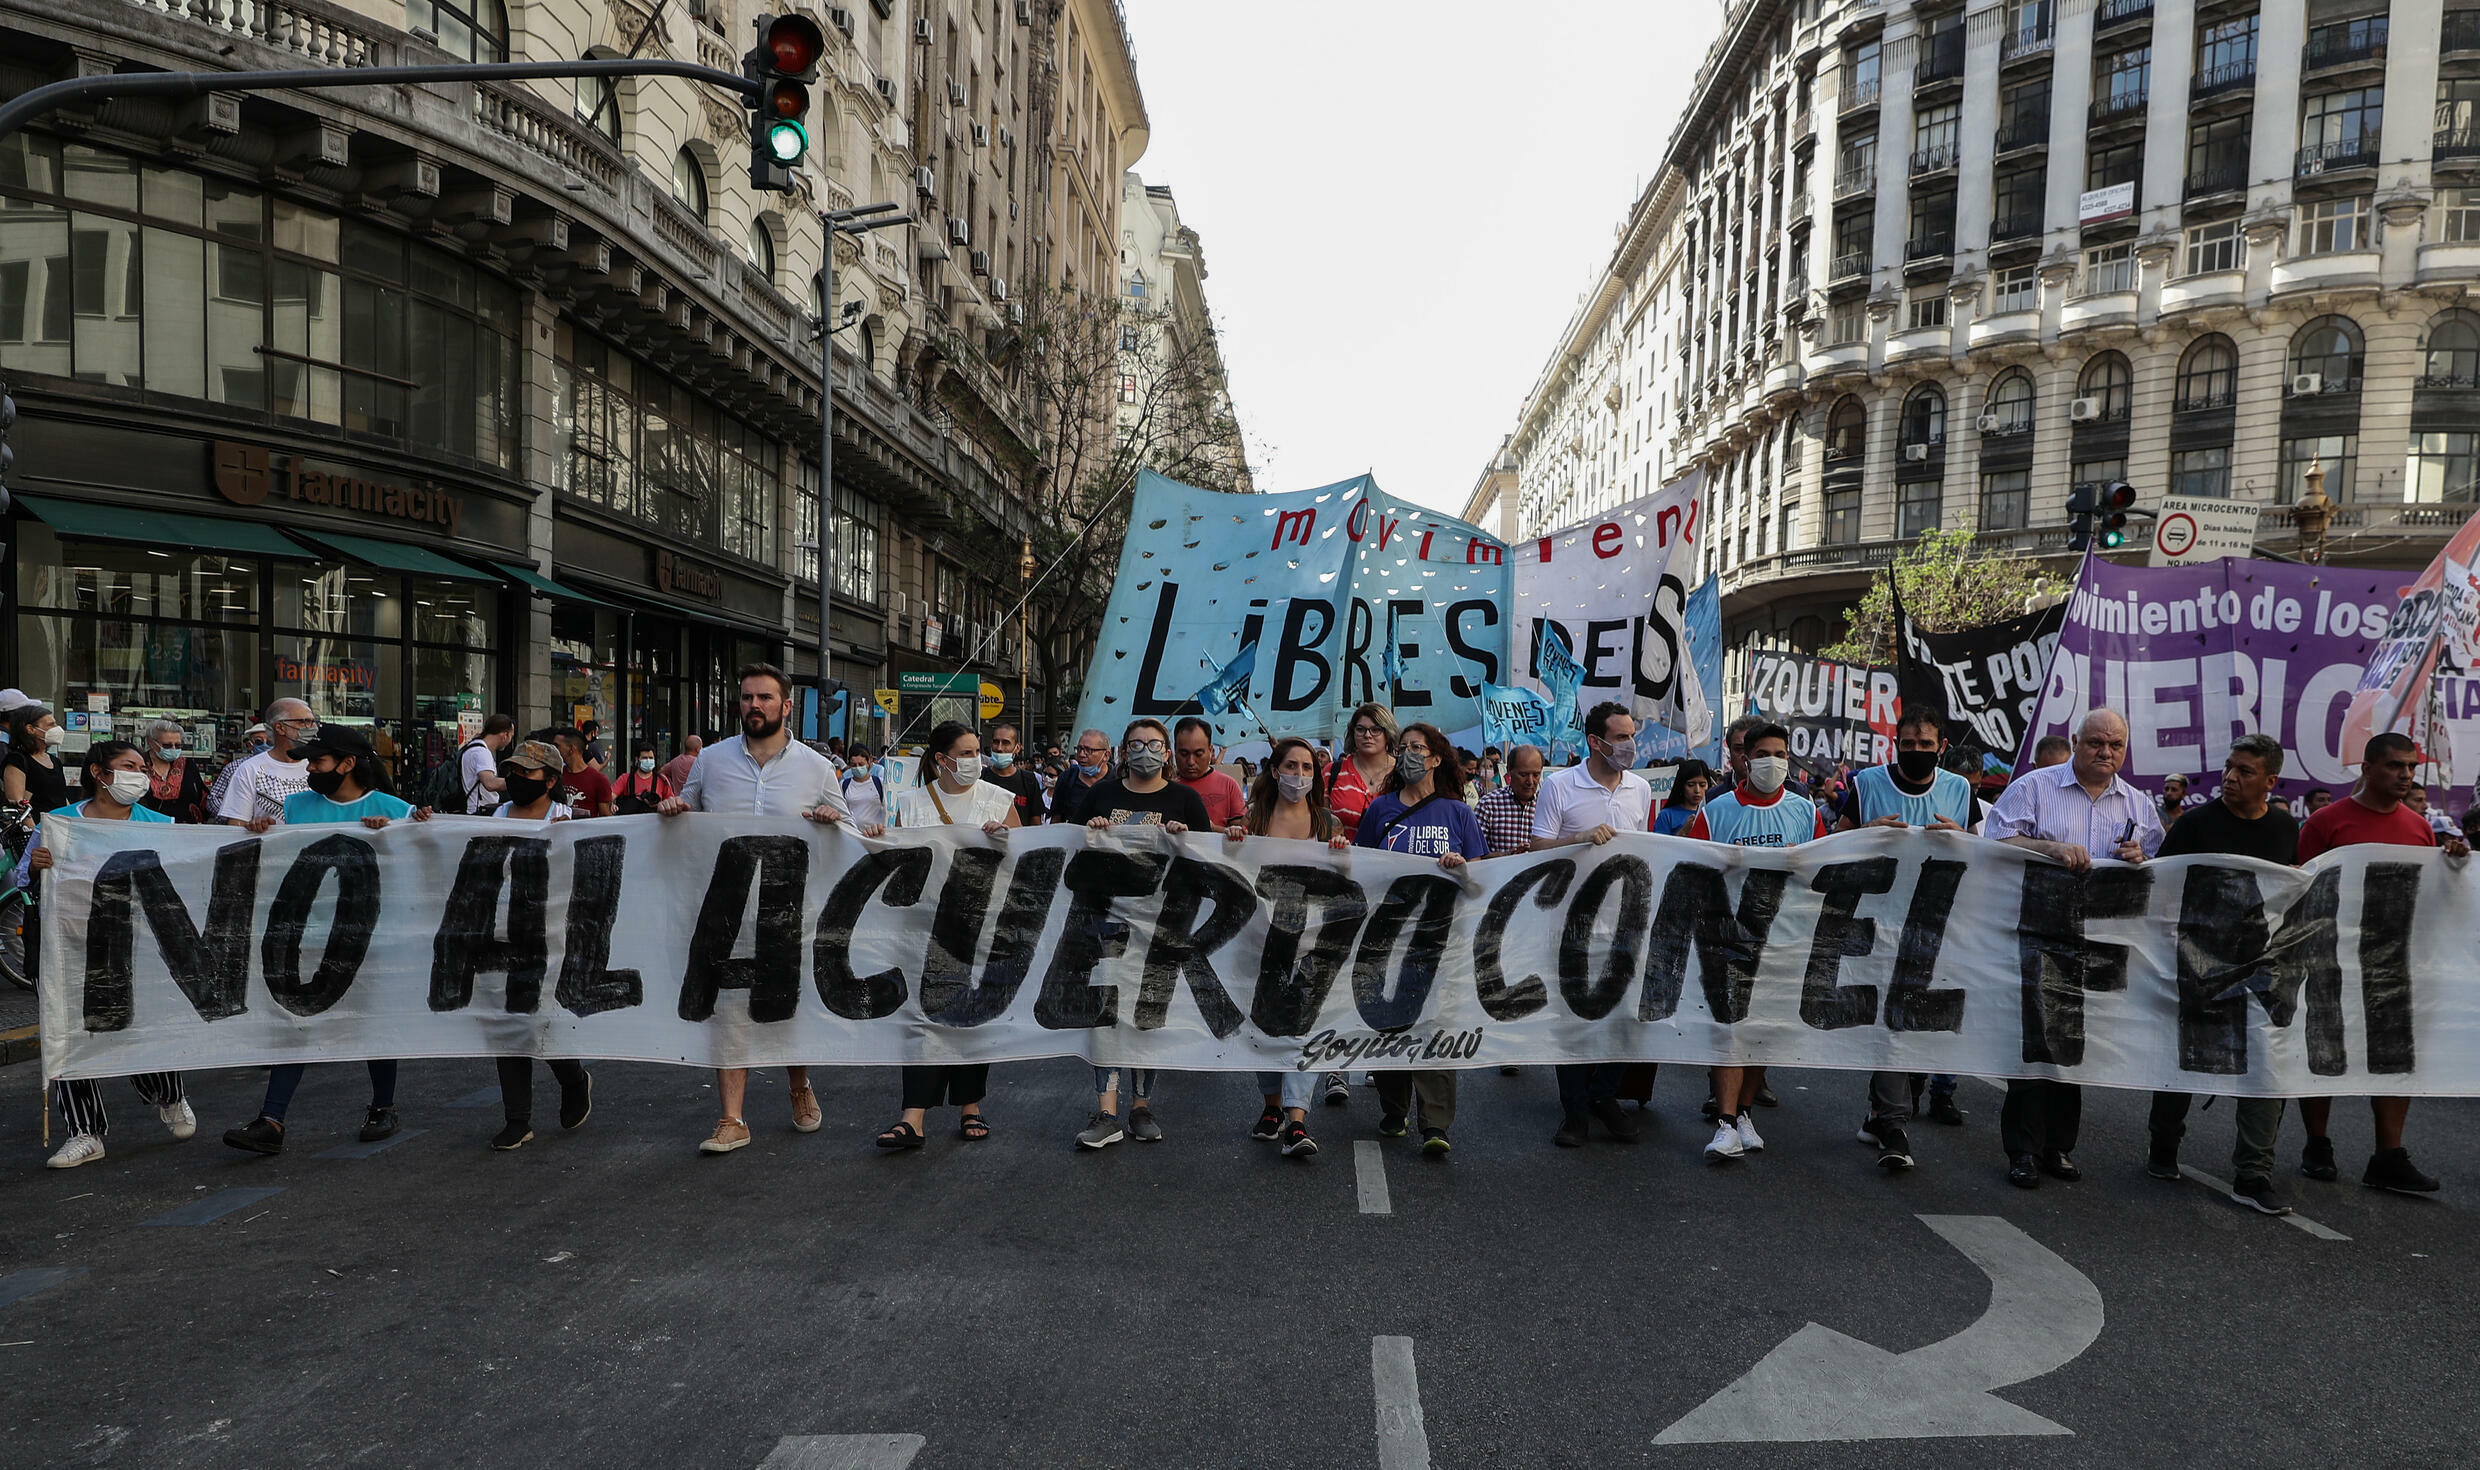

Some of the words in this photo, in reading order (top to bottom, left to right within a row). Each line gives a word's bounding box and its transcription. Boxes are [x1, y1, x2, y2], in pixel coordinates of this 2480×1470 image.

[285, 454, 464, 537] farmacity
[2162, 501, 2187, 510] AREA
[2190, 503, 2258, 515] MICROCENTRO
[2068, 584, 2241, 635] ovimiento
[2250, 585, 2302, 634] de
[2314, 590, 2389, 640] los
[278, 658, 377, 690] farmacity
[902, 674, 935, 683] Catedral
[1416, 826, 1449, 840] LIBRES
[1415, 840, 1431, 854] DEL
[1433, 840, 1450, 854] SUR
[82, 834, 381, 1032] NO
[428, 835, 644, 1018] AL
[678, 834, 1461, 1039] ACUERDO
[1473, 853, 1794, 1023] CON
[1802, 856, 1967, 1035] EL
[2018, 861, 2423, 1076] FMI
